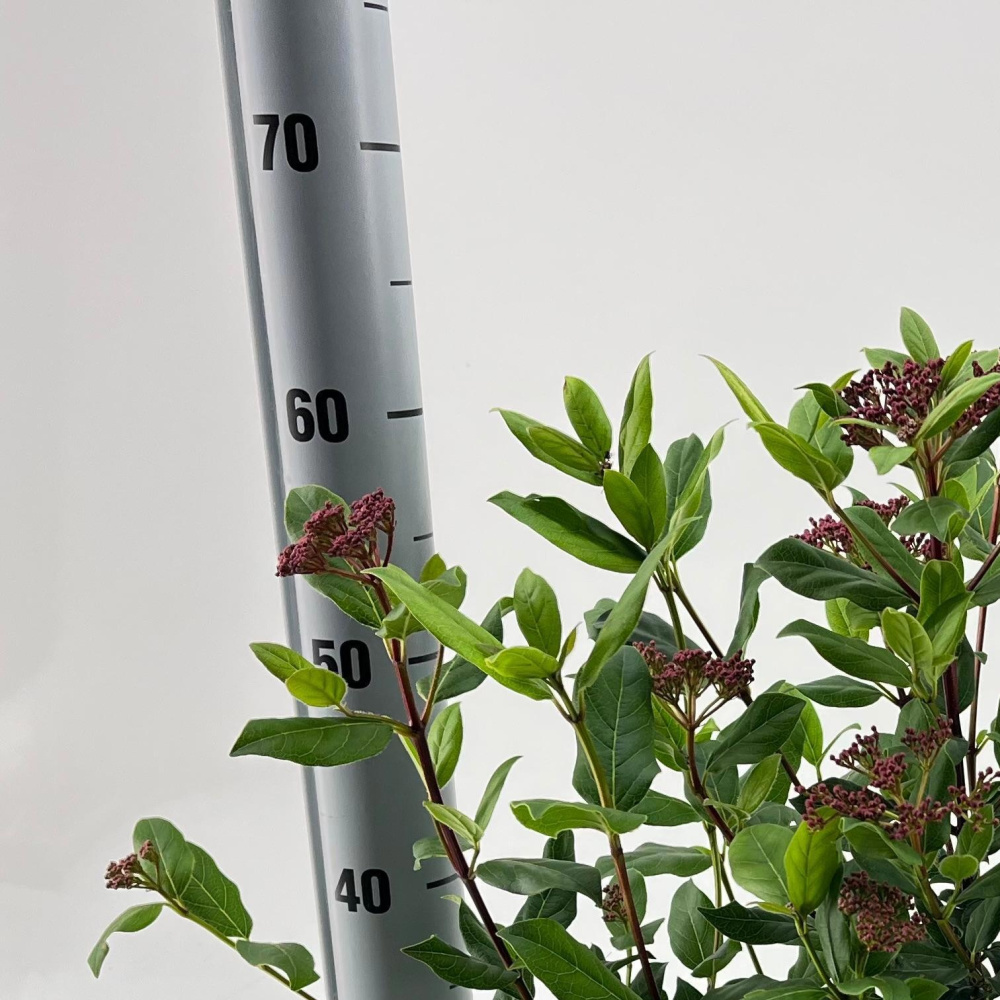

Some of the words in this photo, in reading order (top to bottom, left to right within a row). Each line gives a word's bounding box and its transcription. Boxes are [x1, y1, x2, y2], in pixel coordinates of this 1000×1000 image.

[252, 113, 319, 172] 70
[285, 388, 350, 443] 60
[312, 638, 372, 689] 50
[335, 868, 391, 914] 40
